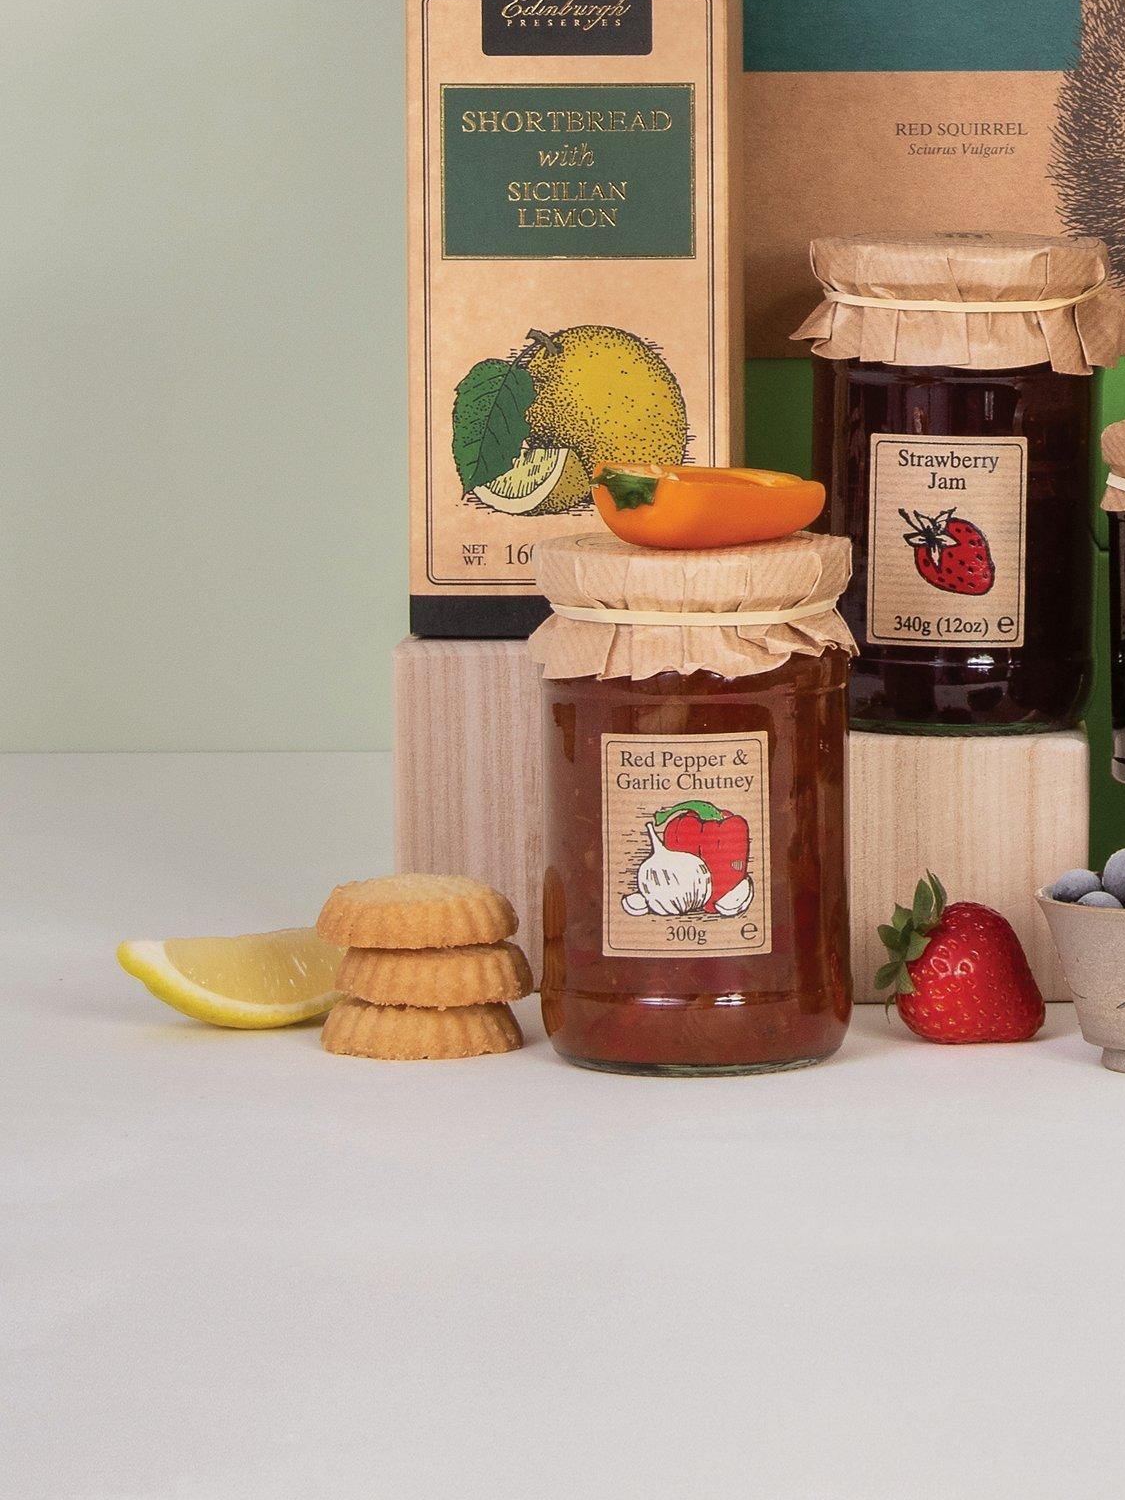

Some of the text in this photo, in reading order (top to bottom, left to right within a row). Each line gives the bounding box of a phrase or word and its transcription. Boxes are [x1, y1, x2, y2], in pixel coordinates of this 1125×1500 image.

[507, 19, 622, 27] PRESERVES
[461, 110, 673, 133] SHORTBREAD
[895, 122, 1028, 138] RED SQUIRREL
[538, 143, 595, 167] with
[908, 143, 1015, 158] Sciurus Vulgaris
[507, 181, 628, 202] SICILIAN
[518, 208, 619, 228] LEMON
[898, 449, 999, 473] Strawberry
[928, 472, 967, 490] Jam
[462, 544, 488, 555] NET
[463, 556, 487, 567] WT.
[894, 615, 931, 635] 340g
[937, 617, 989, 637] (12oz)
[620, 749, 749, 772] Red Pepper &
[616, 773, 754, 792] Garlic Chutney
[666, 926, 707, 944] 300g
